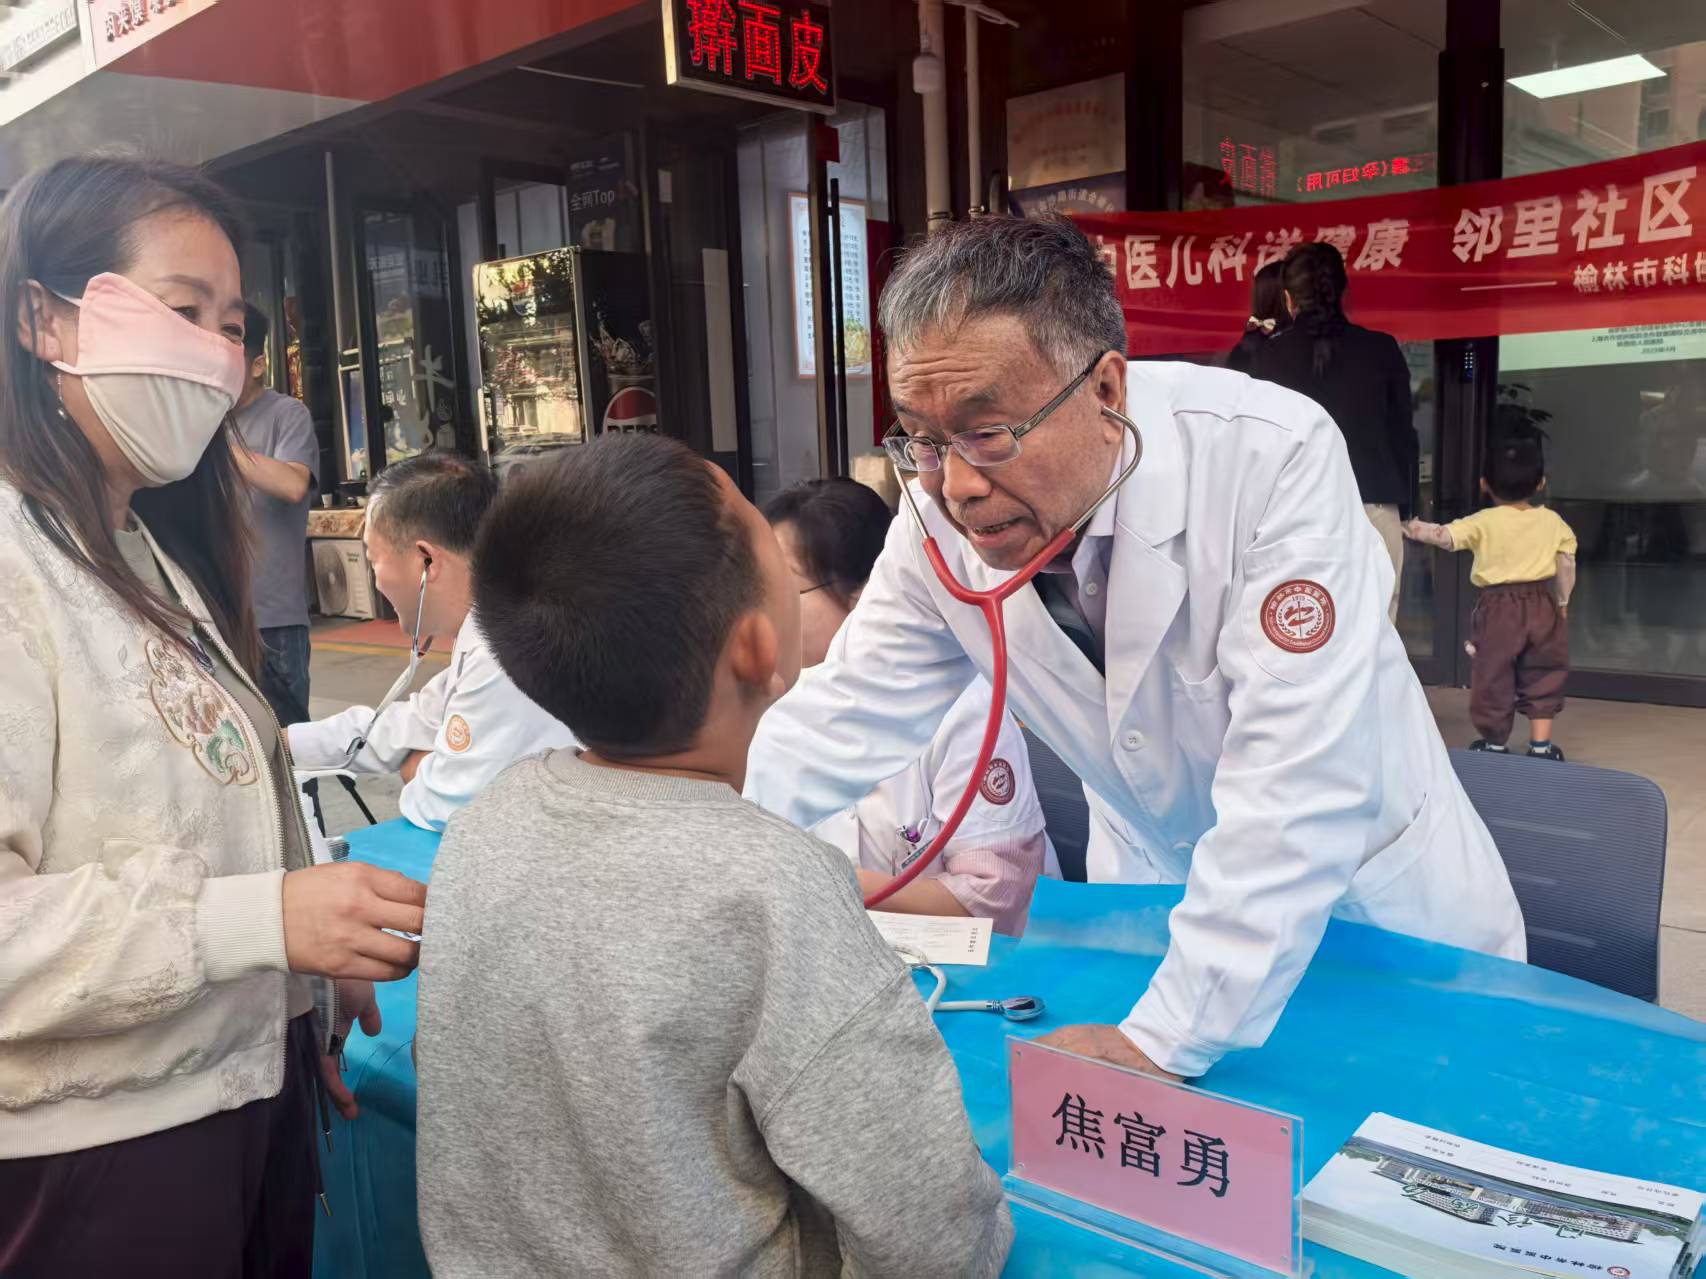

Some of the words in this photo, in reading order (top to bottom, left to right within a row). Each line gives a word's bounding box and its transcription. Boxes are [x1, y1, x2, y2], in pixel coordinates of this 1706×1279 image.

[1452, 166, 1697, 263] 邻里社区
[1052, 1092, 1230, 1198] 焦富勇
